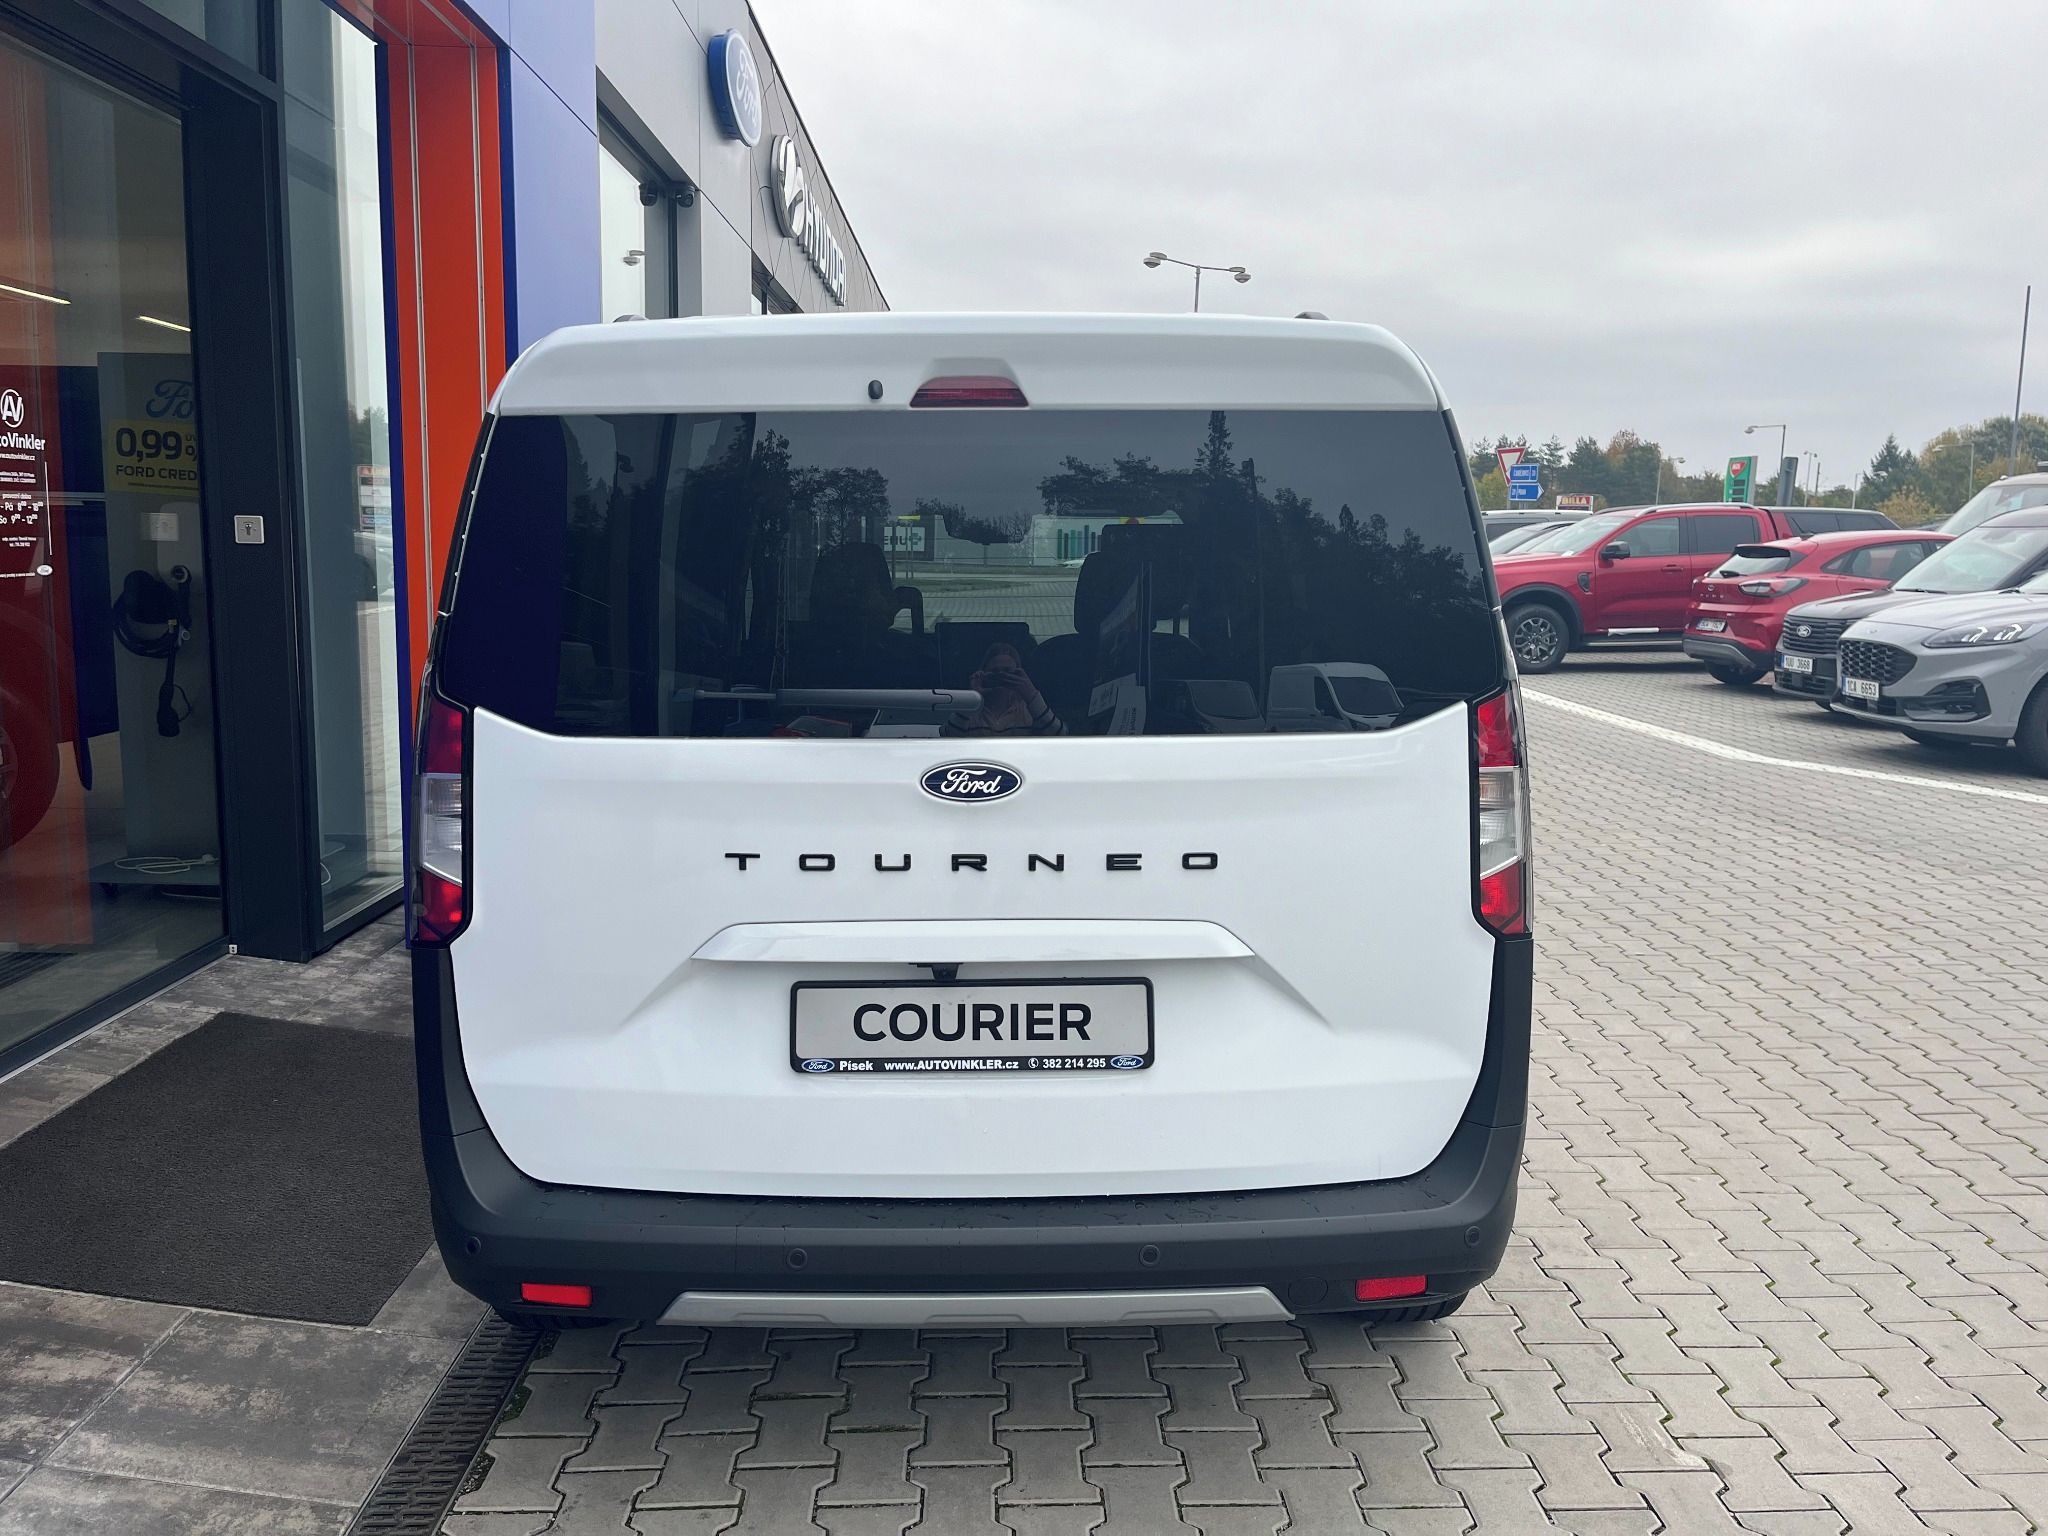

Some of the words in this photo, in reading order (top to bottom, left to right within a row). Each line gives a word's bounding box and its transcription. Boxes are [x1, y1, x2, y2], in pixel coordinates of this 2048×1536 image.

[115, 427, 183, 463] 0,99
[116, 464, 156, 478] FORD
[1561, 496, 1587, 505] BILLA
[1861, 682, 1877, 696] 6653
[939, 768, 1002, 795] Ford
[724, 852, 1219, 872] TOURNEO
[853, 1003, 1092, 1042] COURIER
[839, 1060, 874, 1071] Písek
[884, 1059, 1019, 1071] www.AUTOVINKLER.cz
[1042, 1058, 1062, 1069] 382
[1065, 1058, 1085, 1069] 214
[1087, 1058, 1106, 1069] 295
